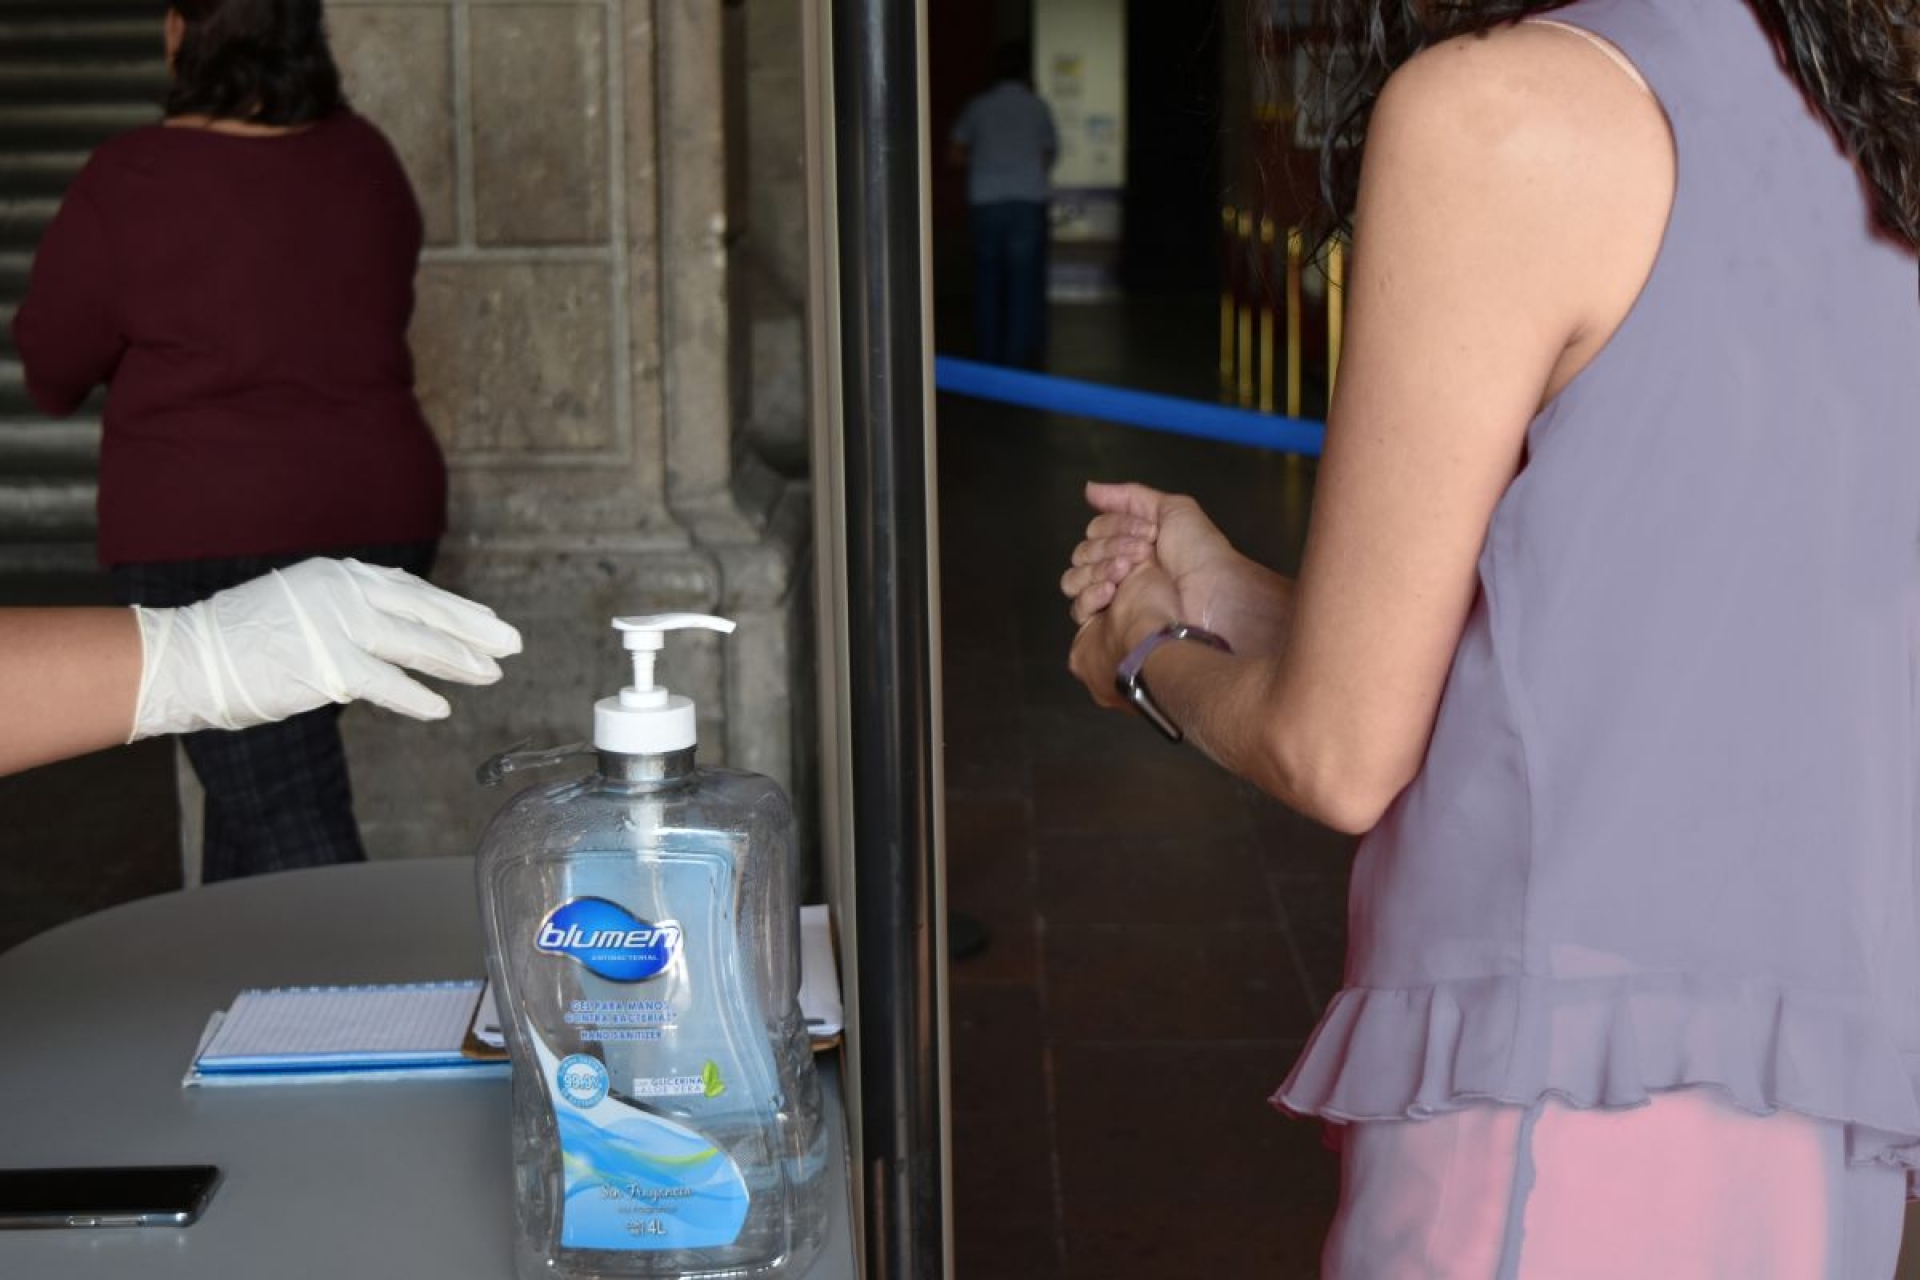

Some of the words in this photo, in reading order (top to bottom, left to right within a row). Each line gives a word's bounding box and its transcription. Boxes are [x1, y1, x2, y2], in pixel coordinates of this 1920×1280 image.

[538, 922, 680, 948] blumen
[627, 1000, 671, 1011] MANO
[647, 1219, 667, 1235] 4L
